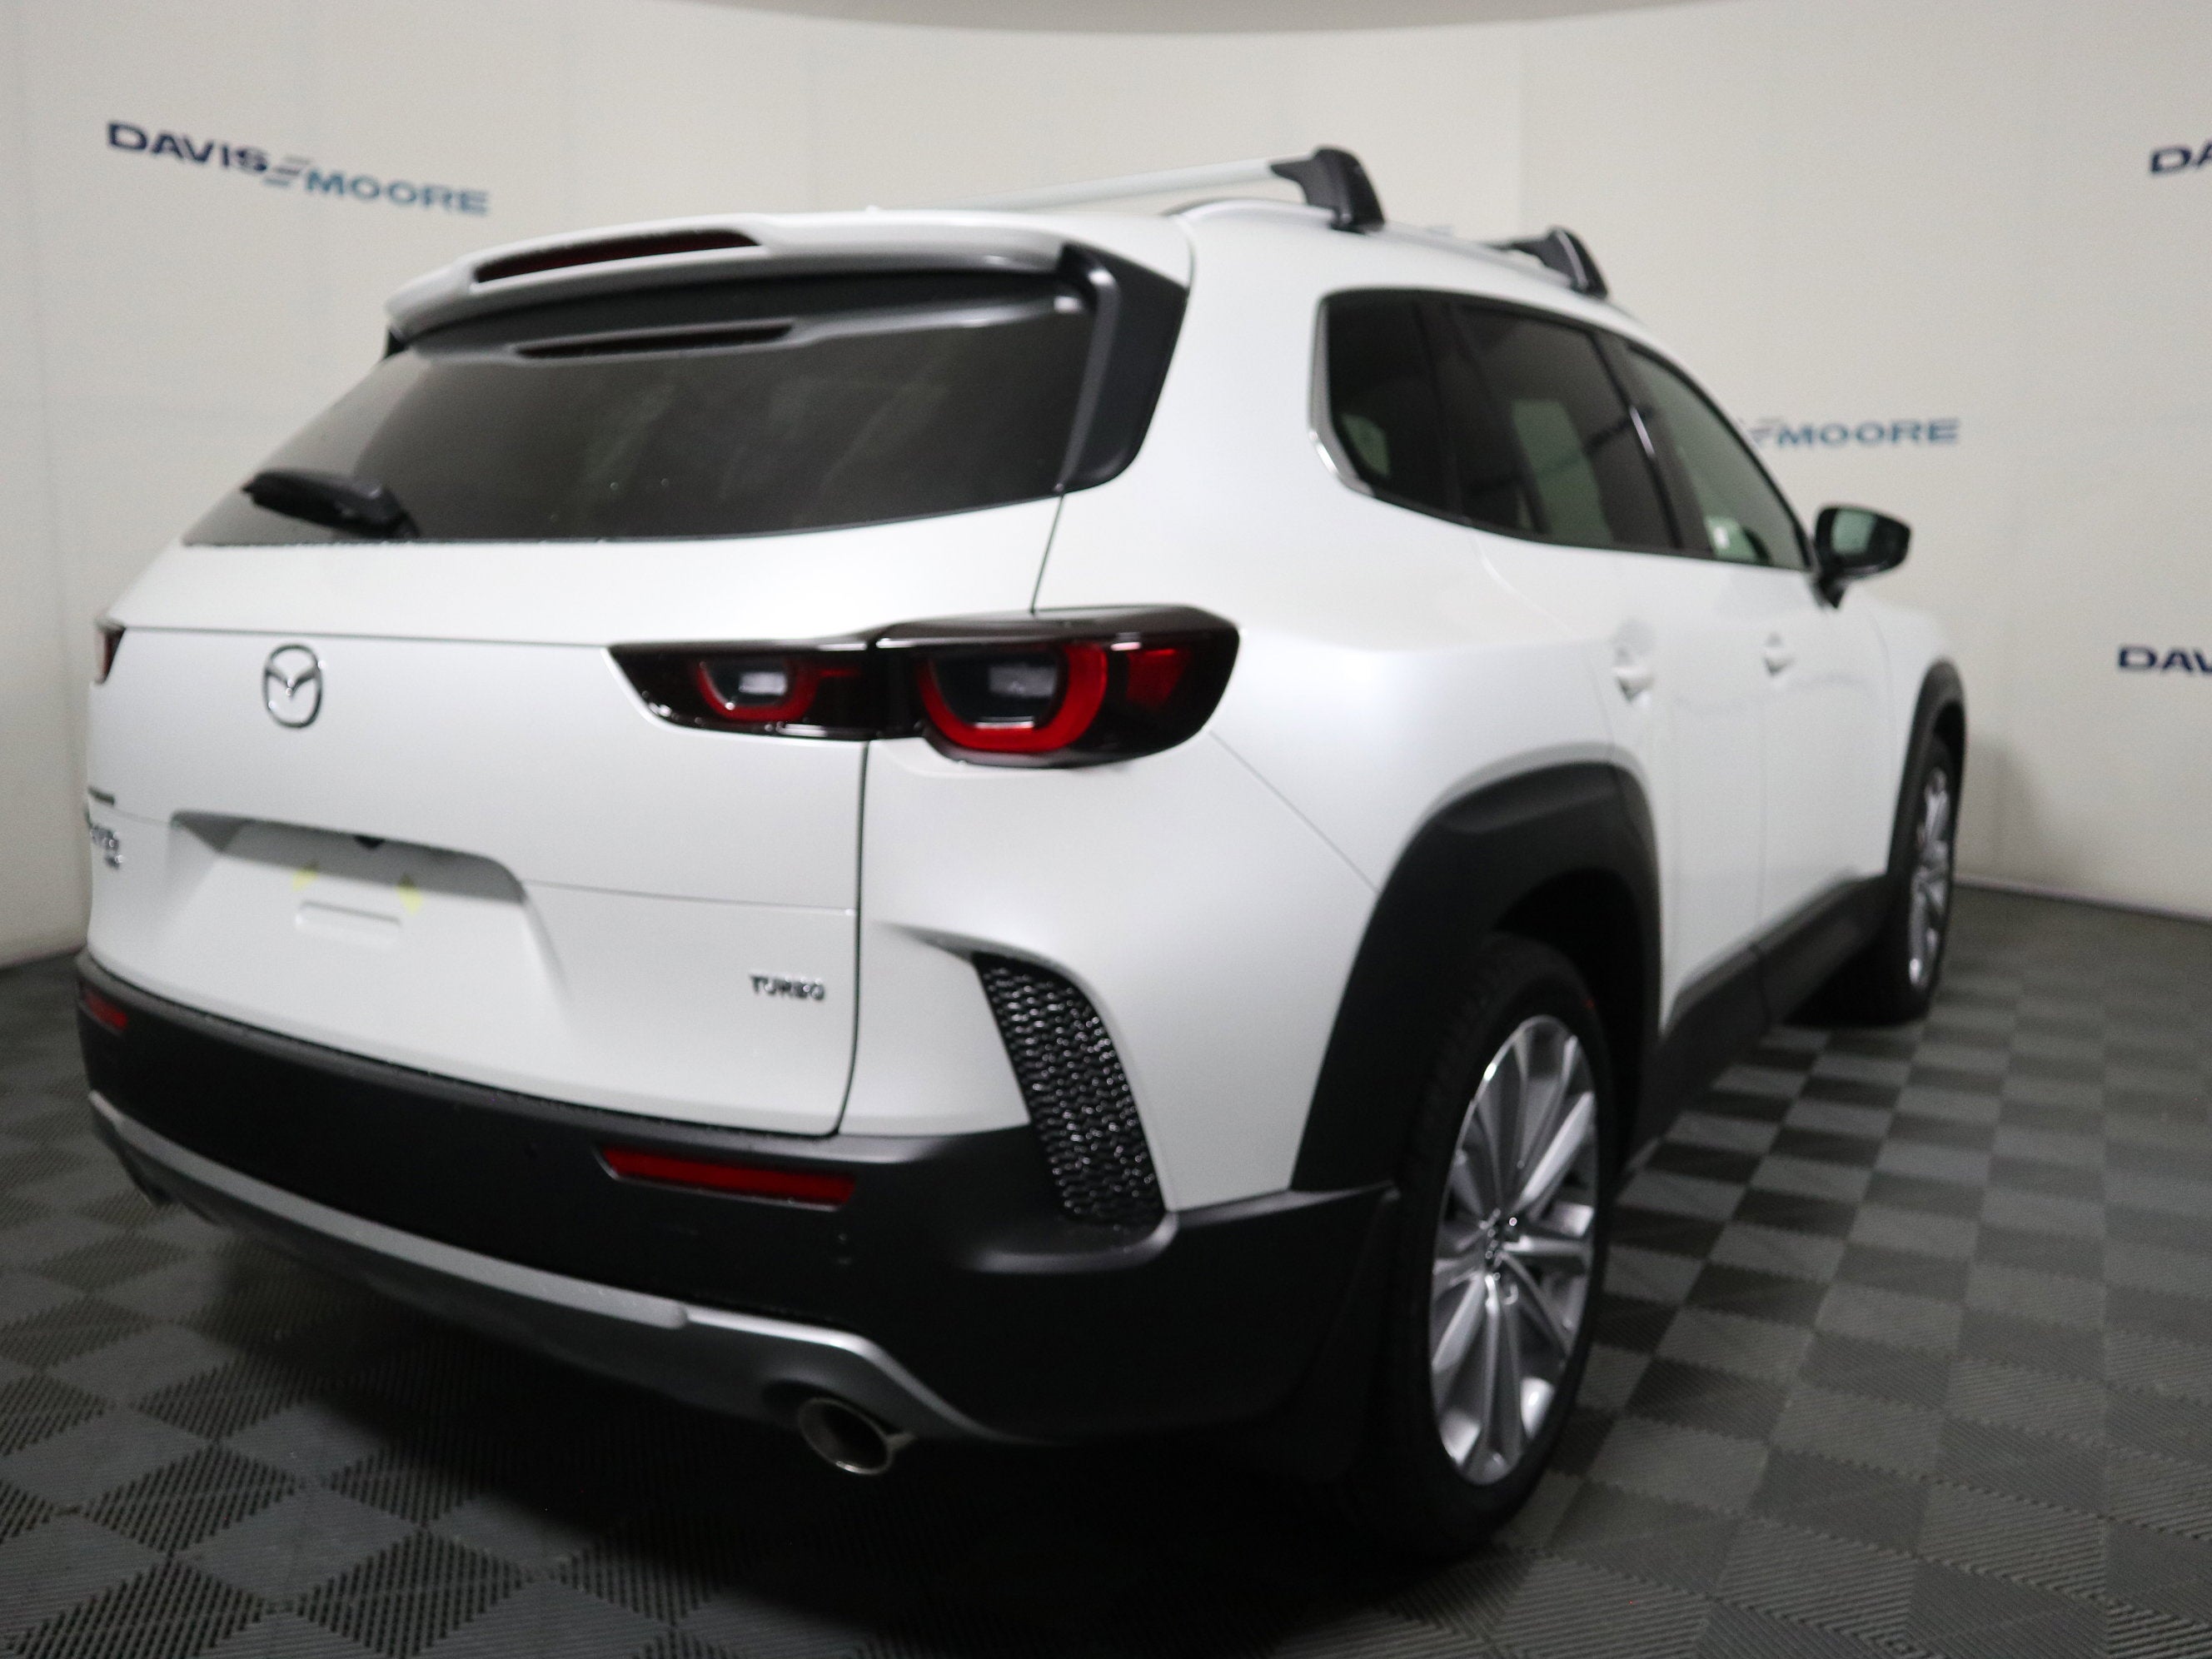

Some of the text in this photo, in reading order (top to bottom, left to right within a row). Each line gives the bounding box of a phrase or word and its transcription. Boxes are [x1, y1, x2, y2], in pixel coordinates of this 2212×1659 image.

[107, 122, 490, 217] DAVIS MOORE
[1776, 419, 1959, 446] MOORE
